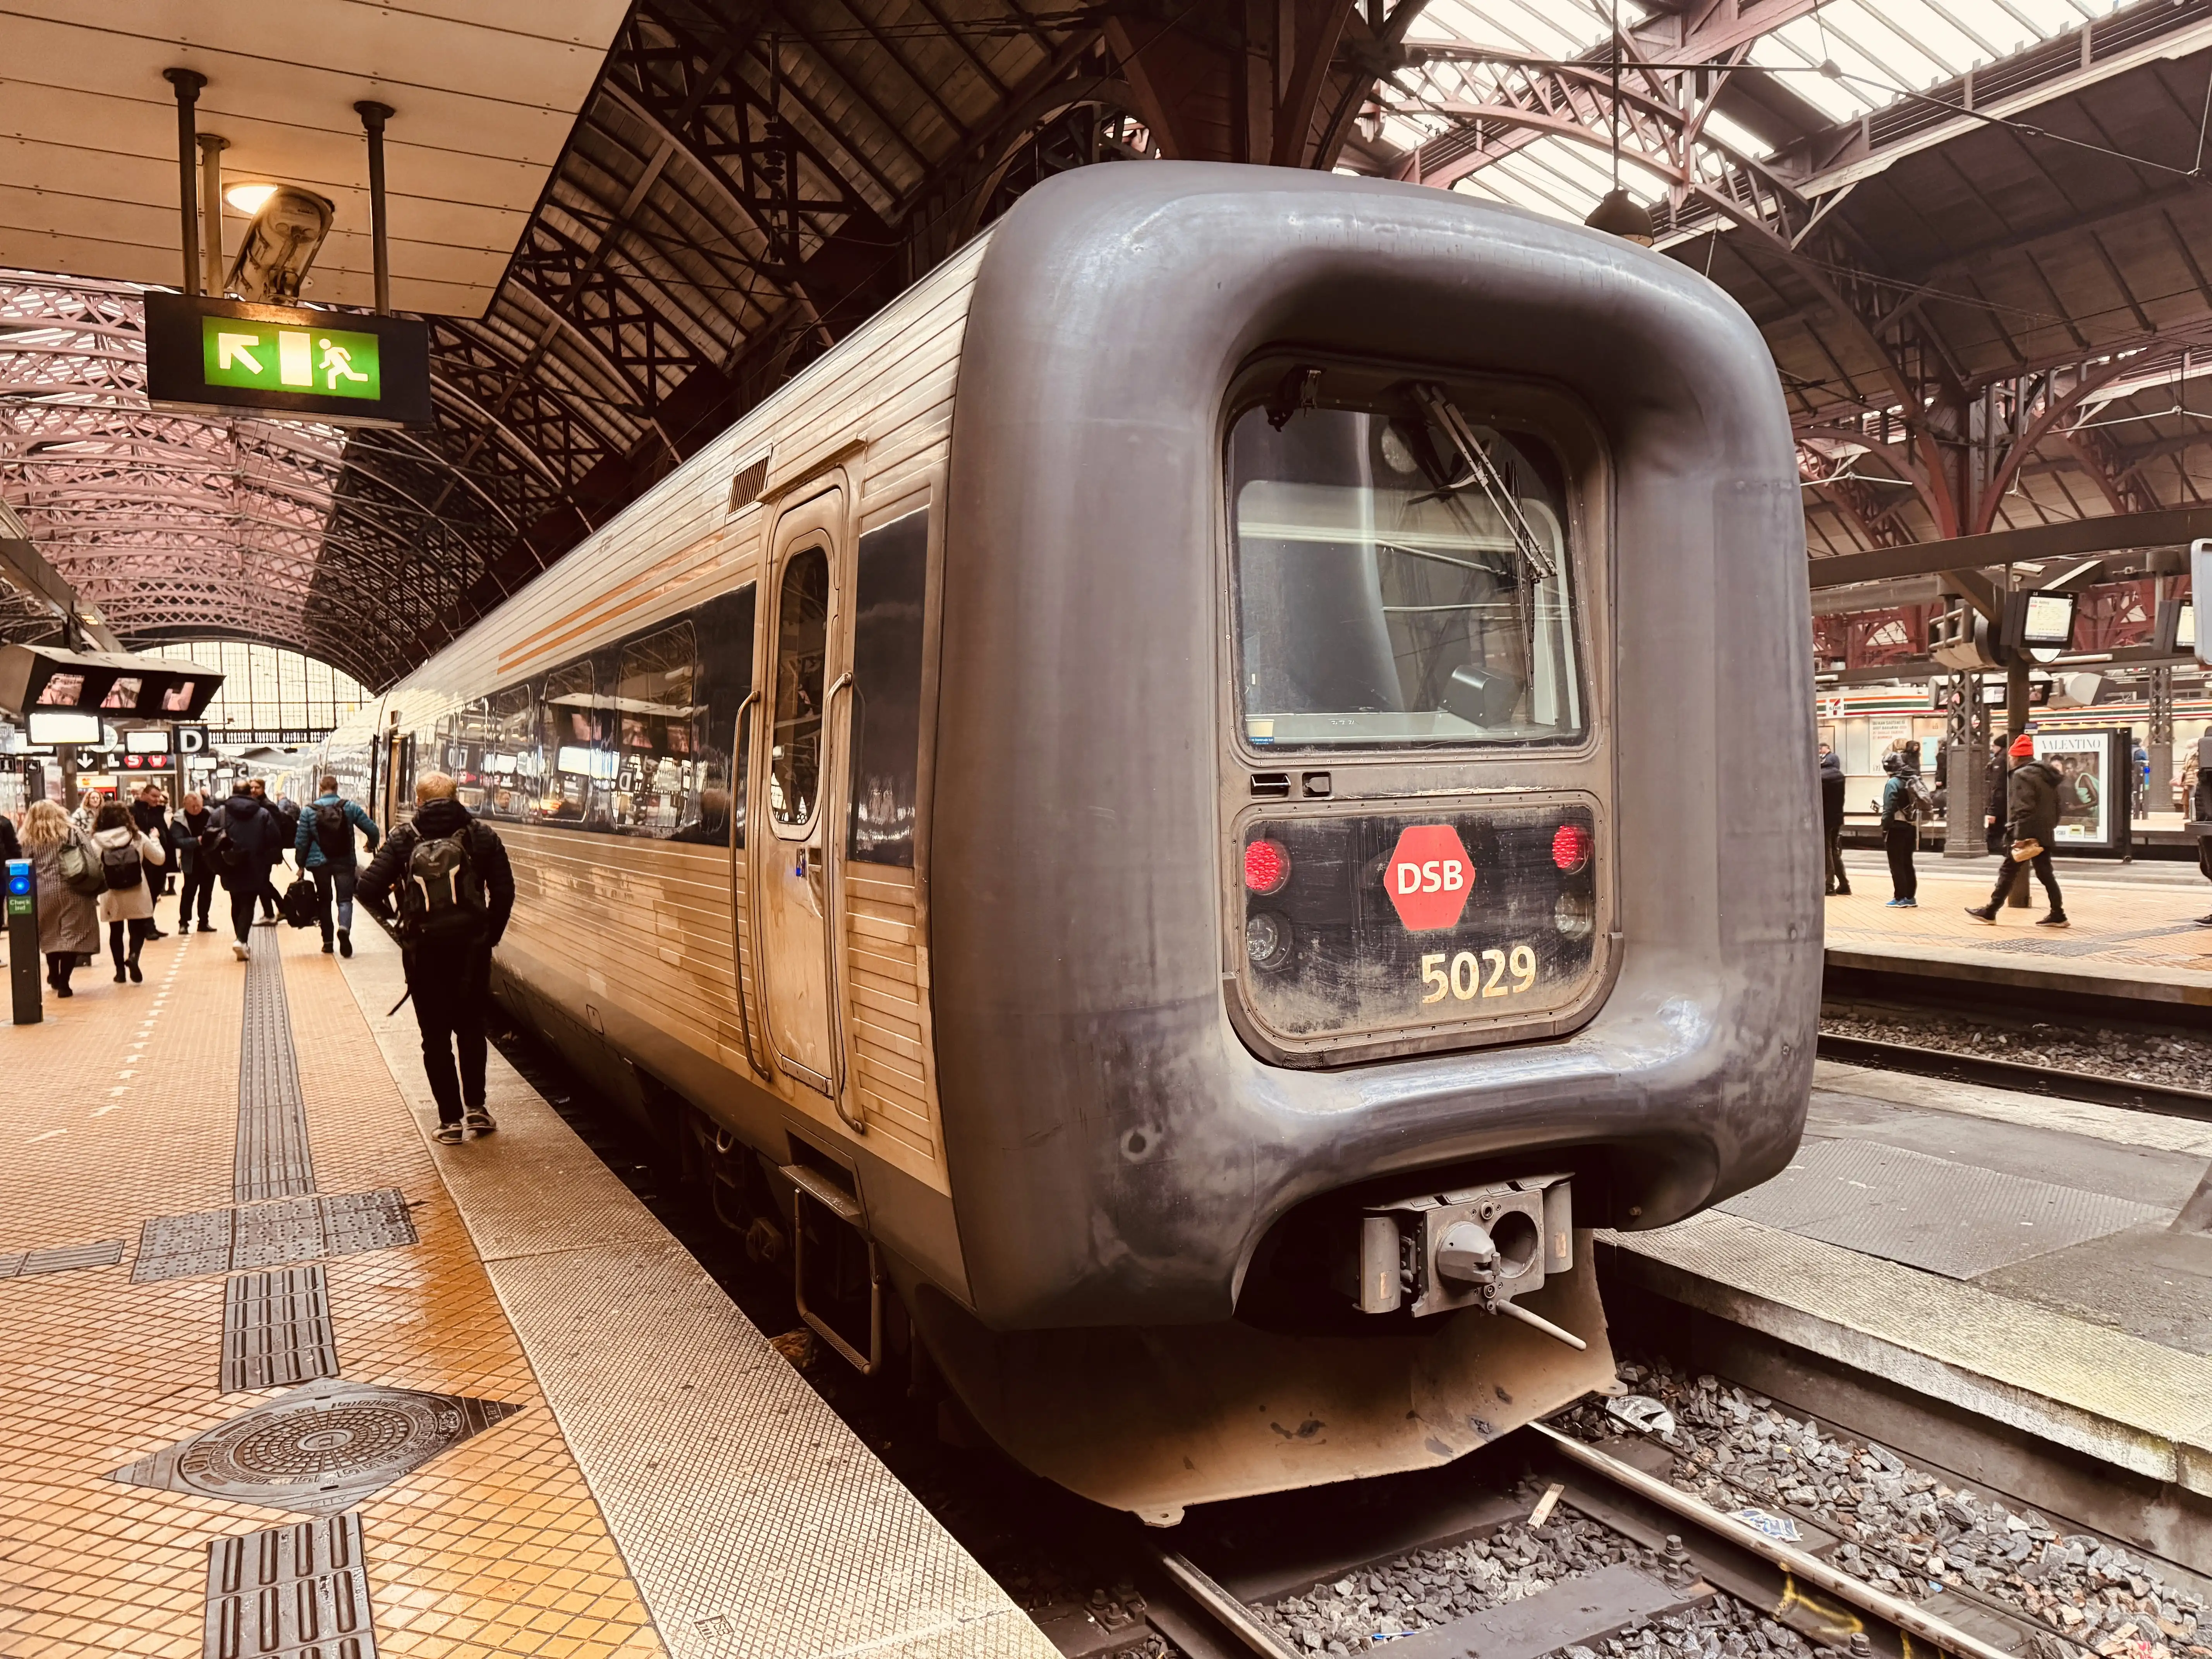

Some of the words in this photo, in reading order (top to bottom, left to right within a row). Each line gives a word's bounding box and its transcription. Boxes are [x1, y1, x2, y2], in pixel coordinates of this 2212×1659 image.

[1829, 698, 1841, 715] 7
[180, 730, 203, 753] D
[2042, 739, 2101, 750] VALENTINO
[1397, 860, 1463, 895] DSB
[1422, 945, 1537, 1003] 5029
[709, 1617, 730, 1636] DSB
